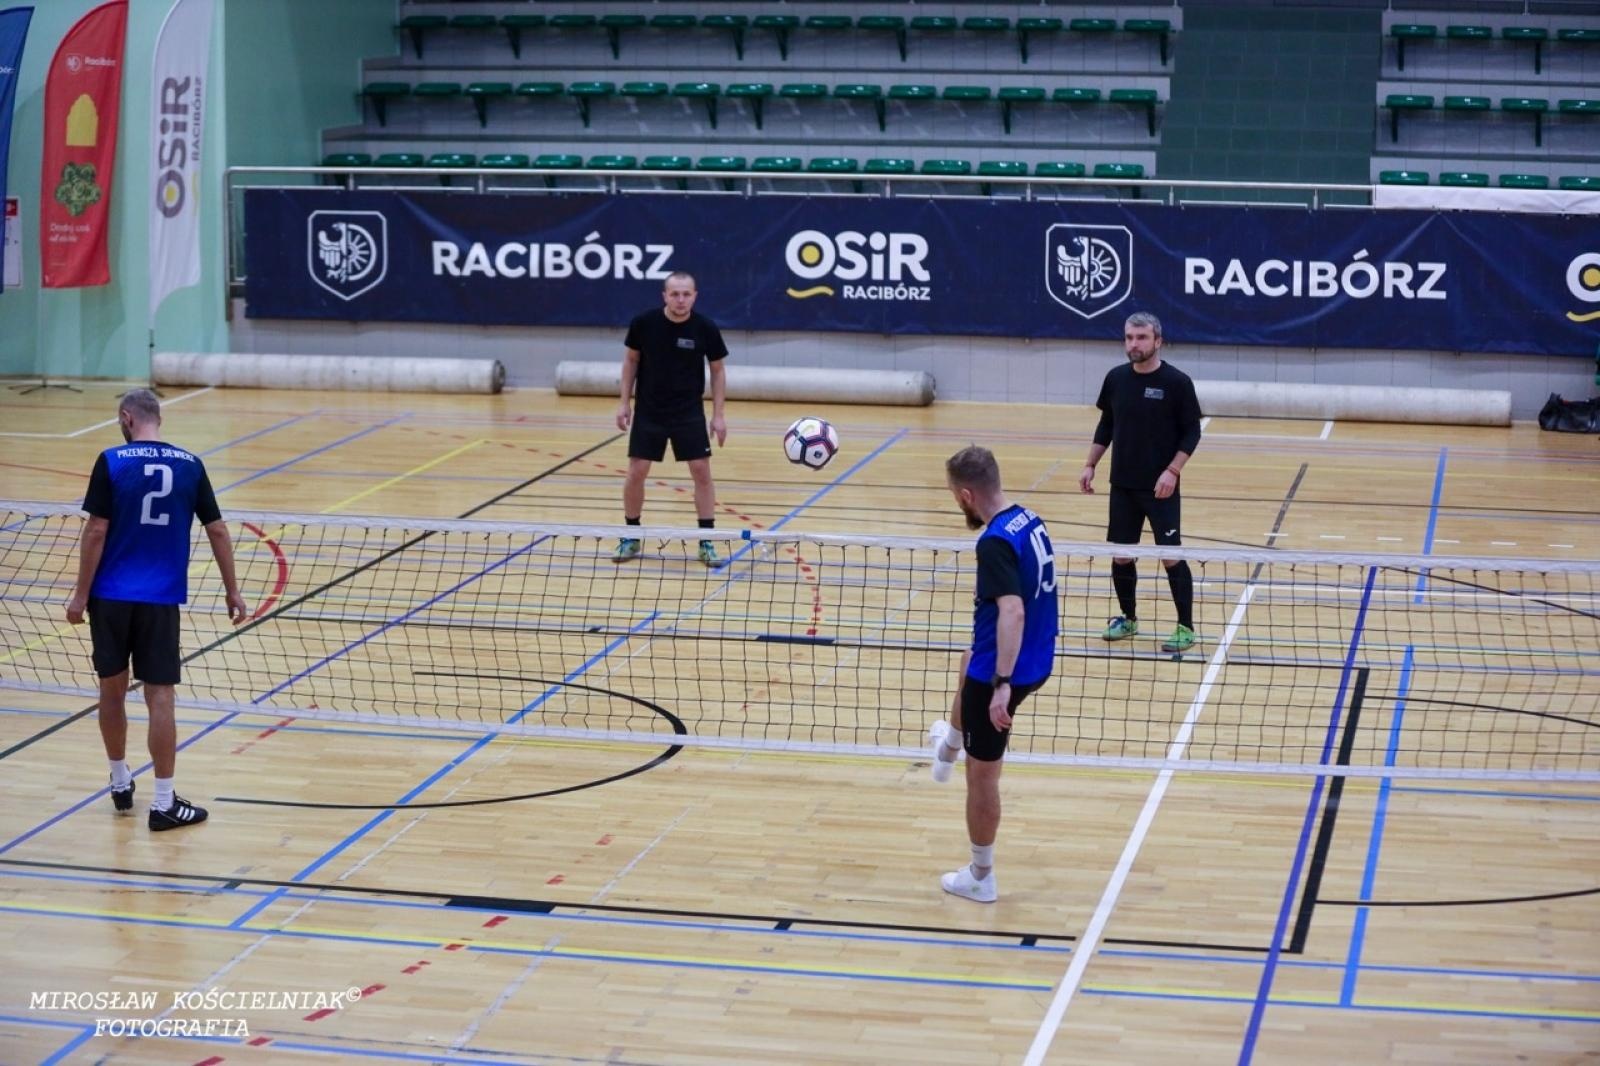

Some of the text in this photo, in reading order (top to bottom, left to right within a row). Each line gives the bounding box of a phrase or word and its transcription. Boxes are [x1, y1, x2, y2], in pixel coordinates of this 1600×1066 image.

[431, 230, 674, 280] RACIBÓRZ
[1183, 248, 1448, 300] RACIBÓRZ
[842, 283, 931, 301] RACIBÓRZ
[140, 463, 174, 526] 2
